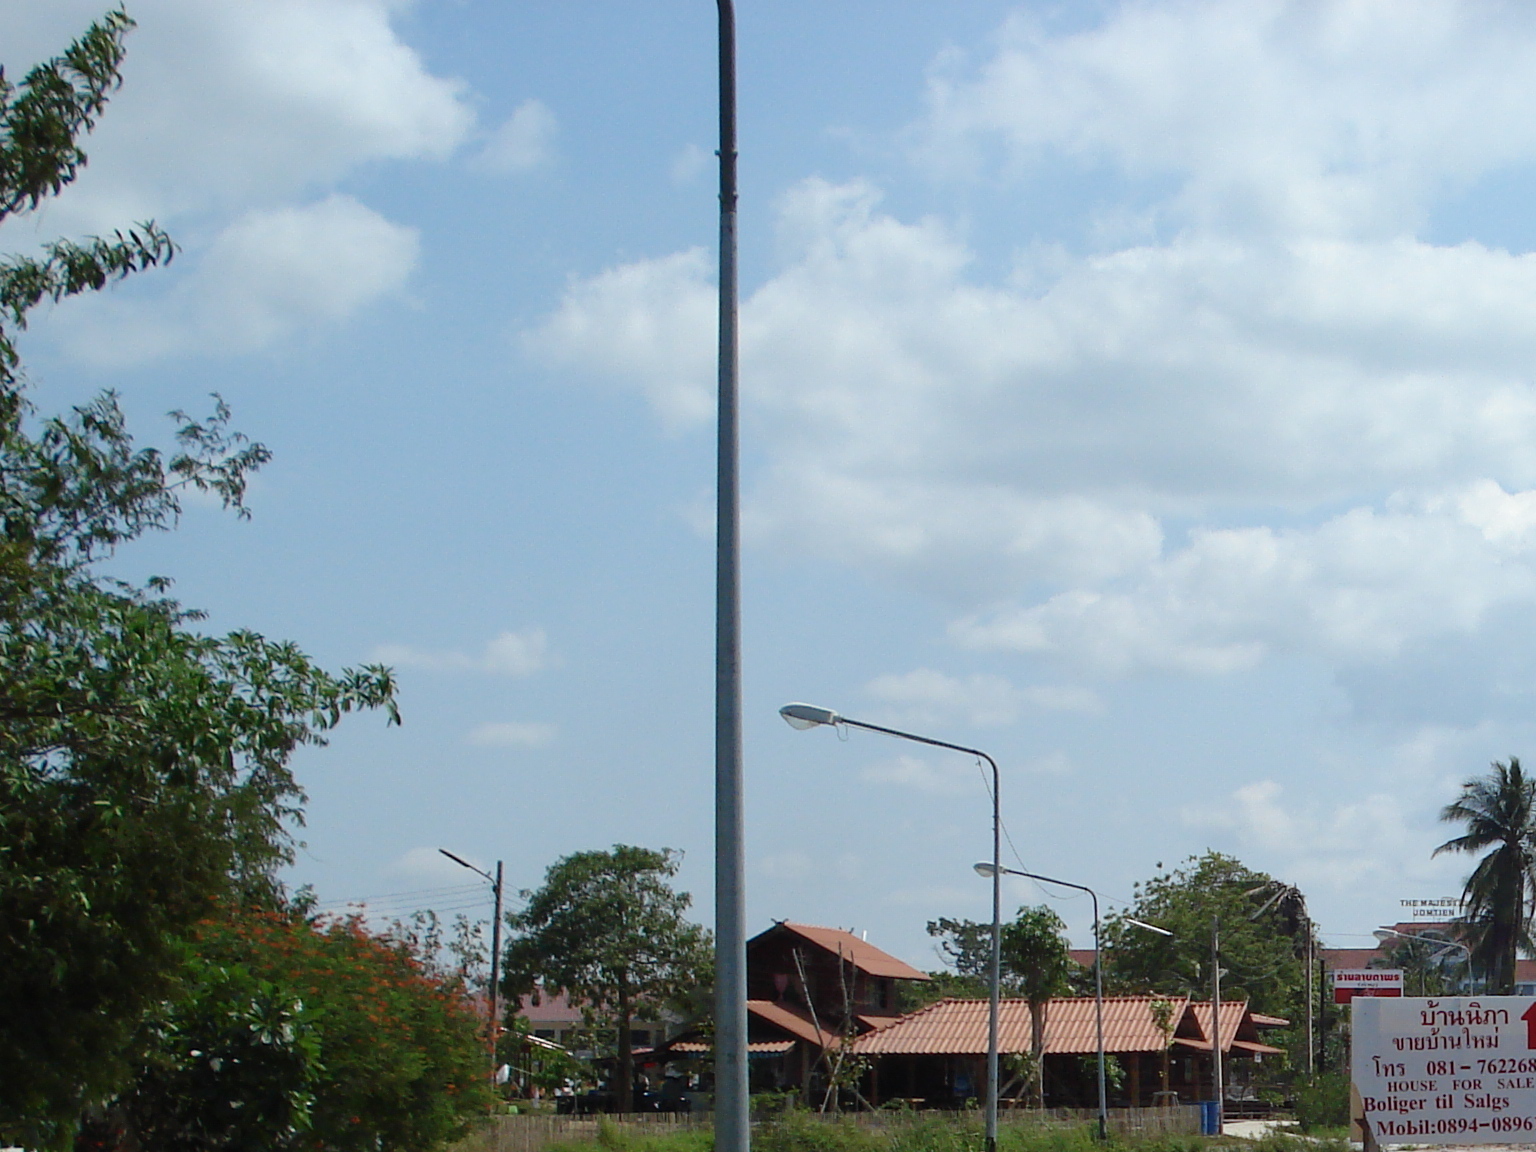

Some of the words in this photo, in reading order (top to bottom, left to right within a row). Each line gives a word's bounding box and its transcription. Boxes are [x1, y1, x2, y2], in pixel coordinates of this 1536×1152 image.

[1400, 899, 1417, 907] THE
[1420, 1000, 1509, 1026] บ้านนิภา
[1392, 1026, 1499, 1051] ขายบ้านใหม่
[1372, 1055, 1405, 1077] โทร
[1387, 1080, 1438, 1093] HOUSE
[1452, 1079, 1483, 1091] FOR
[1497, 1077, 1535, 1090] SALE
[1364, 1095, 1427, 1115] Boliger
[1435, 1093, 1453, 1109] til
[1464, 1093, 1510, 1113] Salgs
